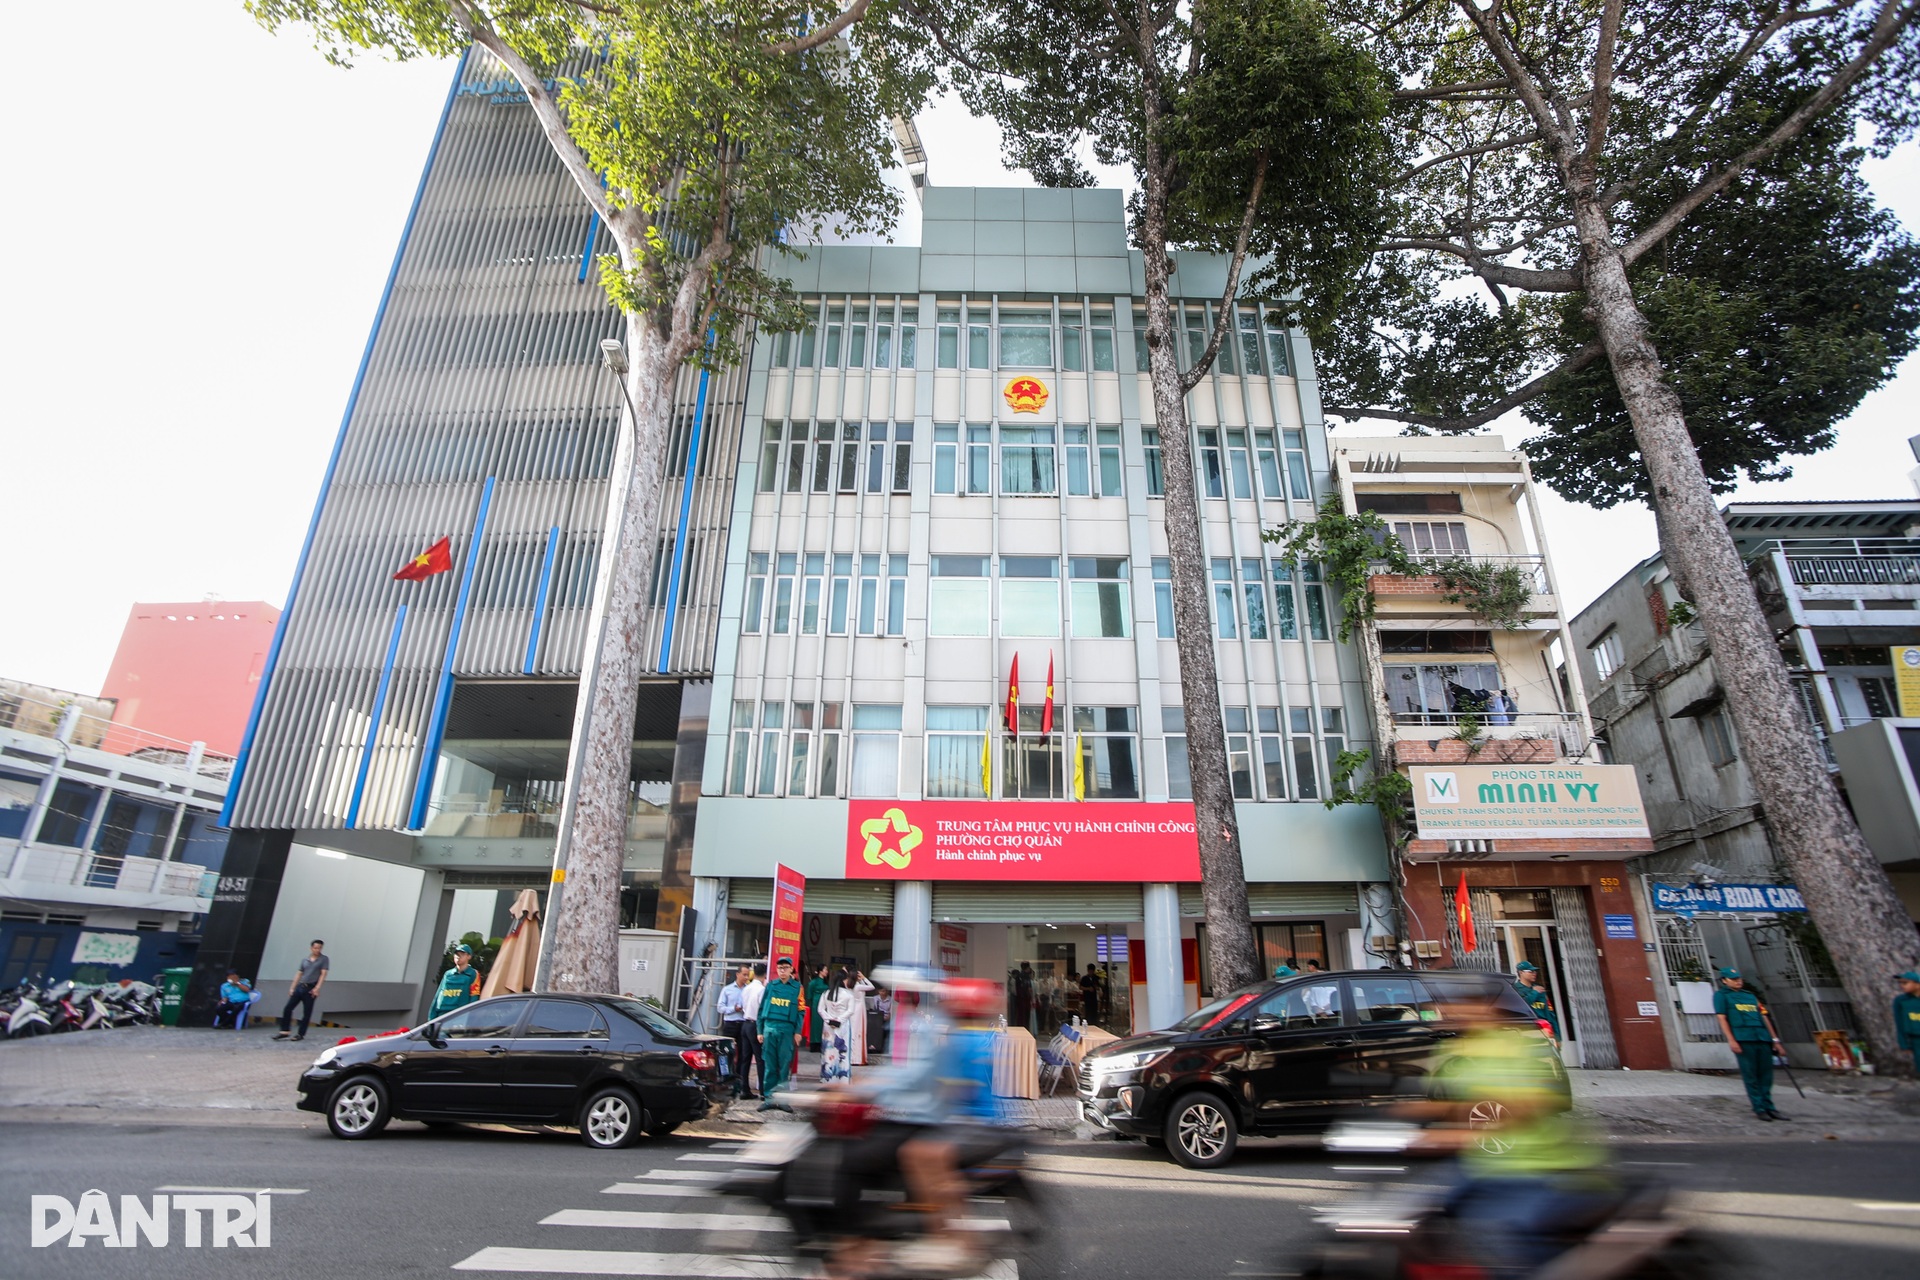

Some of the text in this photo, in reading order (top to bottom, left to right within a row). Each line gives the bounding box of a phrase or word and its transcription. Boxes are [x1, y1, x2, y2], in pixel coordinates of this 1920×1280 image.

[1492, 767, 1583, 780] PHÒNG TRANH
[1478, 783, 1600, 803] MINH VY
[936, 818, 1195, 834] TRUNG TÂM PHỤC VỤ HÀNH CHÍNH CÔNG
[1464, 819, 1486, 827] THEO
[936, 832, 991, 846] PHƯỜNG
[993, 834, 1022, 848] CHỢ
[936, 849, 1042, 864] Hành chính phục vụ
[218, 877, 248, 892] 49-51
[1600, 878, 1619, 886] 55D
[1704, 886, 1722, 904] BỘ
[1722, 887, 1768, 908] BIDA
[1766, 887, 1805, 908] CAR
[561, 973, 574, 983] 59
